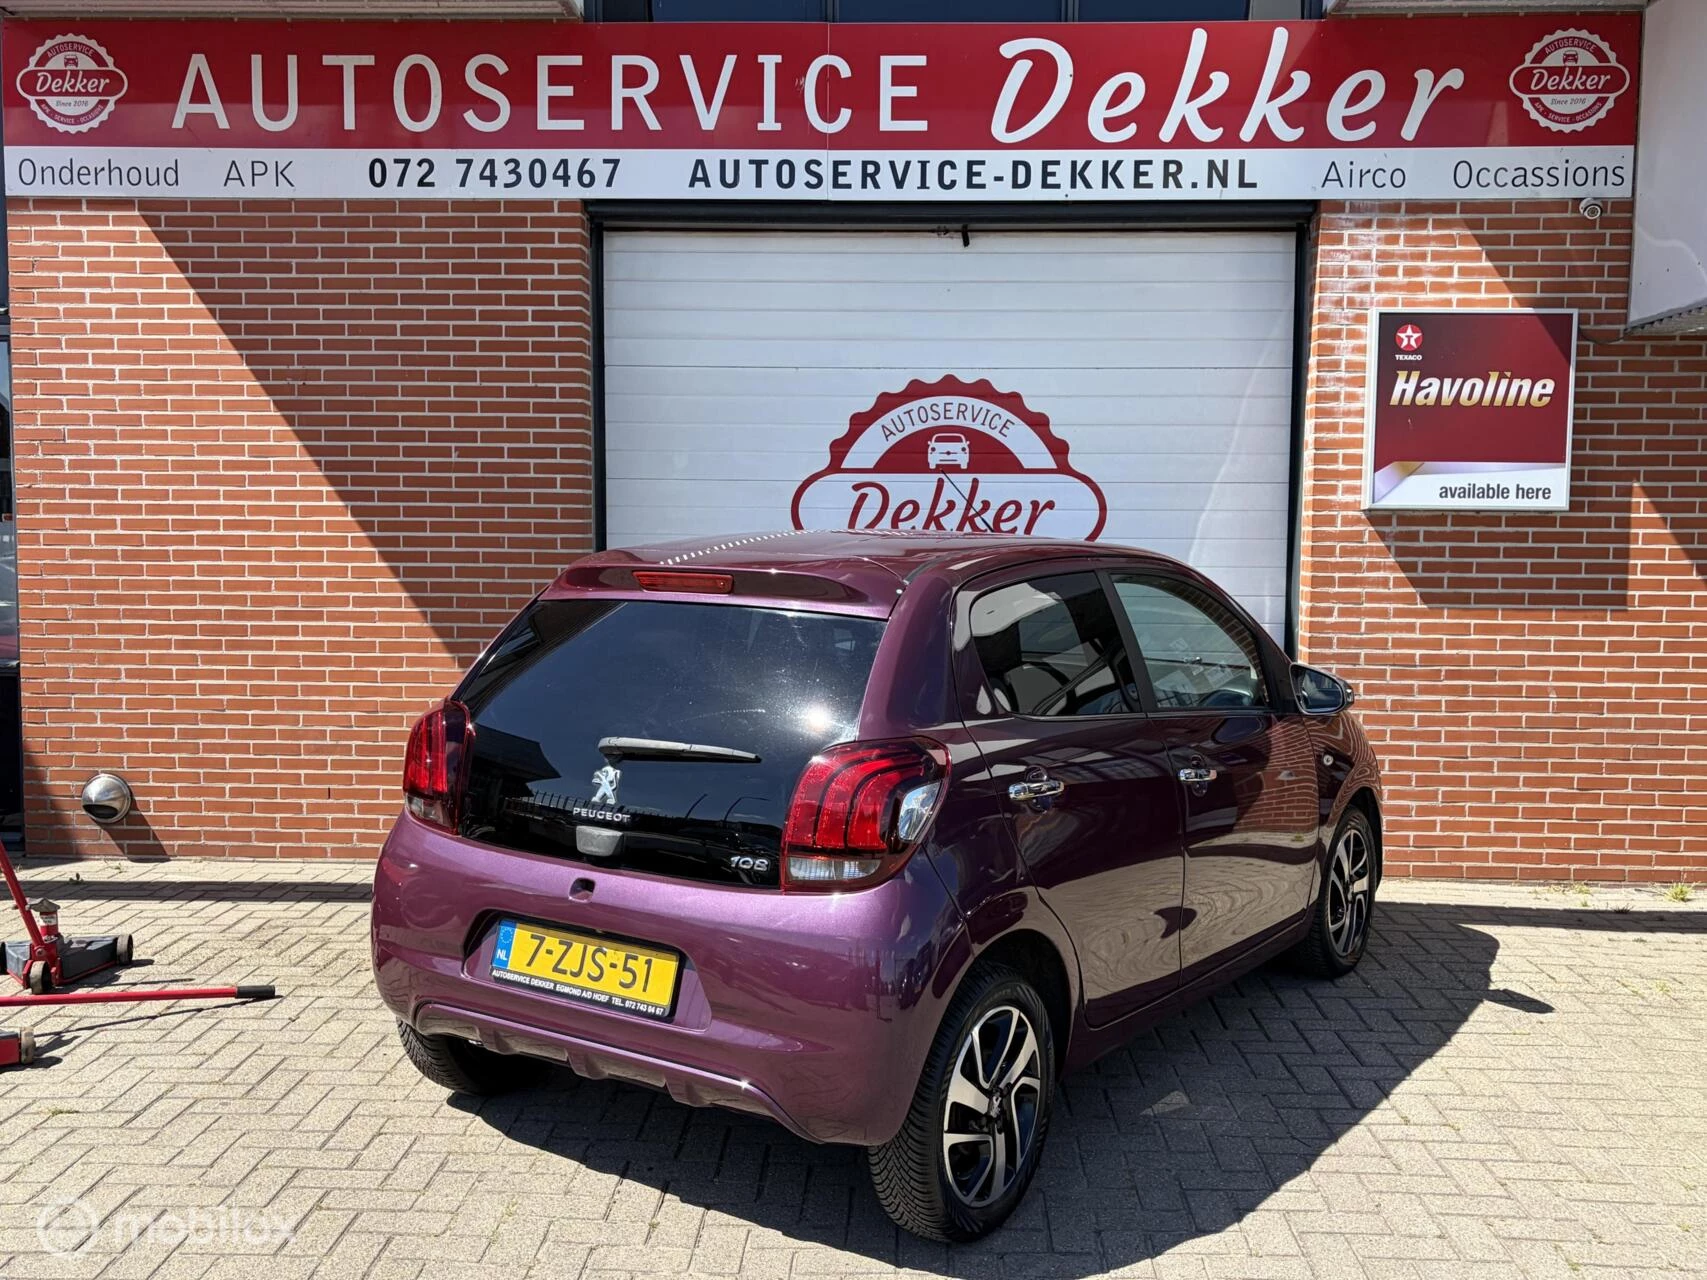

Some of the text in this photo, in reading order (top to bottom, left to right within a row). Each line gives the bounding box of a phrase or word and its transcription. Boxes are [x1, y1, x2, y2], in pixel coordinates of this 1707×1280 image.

[47, 43, 94, 58] AUTOSERVICE
[1544, 38, 1597, 55] AUTOSERVICE
[36, 70, 110, 93] Dekker
[171, 26, 1465, 144] AUTOSERVICE Dekker
[1530, 66, 1611, 91] Dekker
[17, 158, 1625, 190] Onderhoud APK 072 7430467 AUTOSERVICE-DEKKER.NL Airco Occassions
[1389, 370, 1556, 408] Havoline
[881, 402, 1016, 442] AUTOSERVICE
[1438, 483, 1552, 500] available here
[848, 477, 1056, 535] Dekker
[572, 807, 631, 823] PEUGEOT
[730, 855, 769, 872] 108
[496, 949, 508, 961] NL
[526, 933, 653, 993] 7-ZJS-51
[492, 969, 530, 985] AUTOSERVICE
[530, 978, 554, 990] DEKKER
[556, 984, 582, 997] EGMOND
[593, 992, 610, 1003] HOEF
[625, 1000, 636, 1010] 072
[636, 1002, 648, 1012] 743
